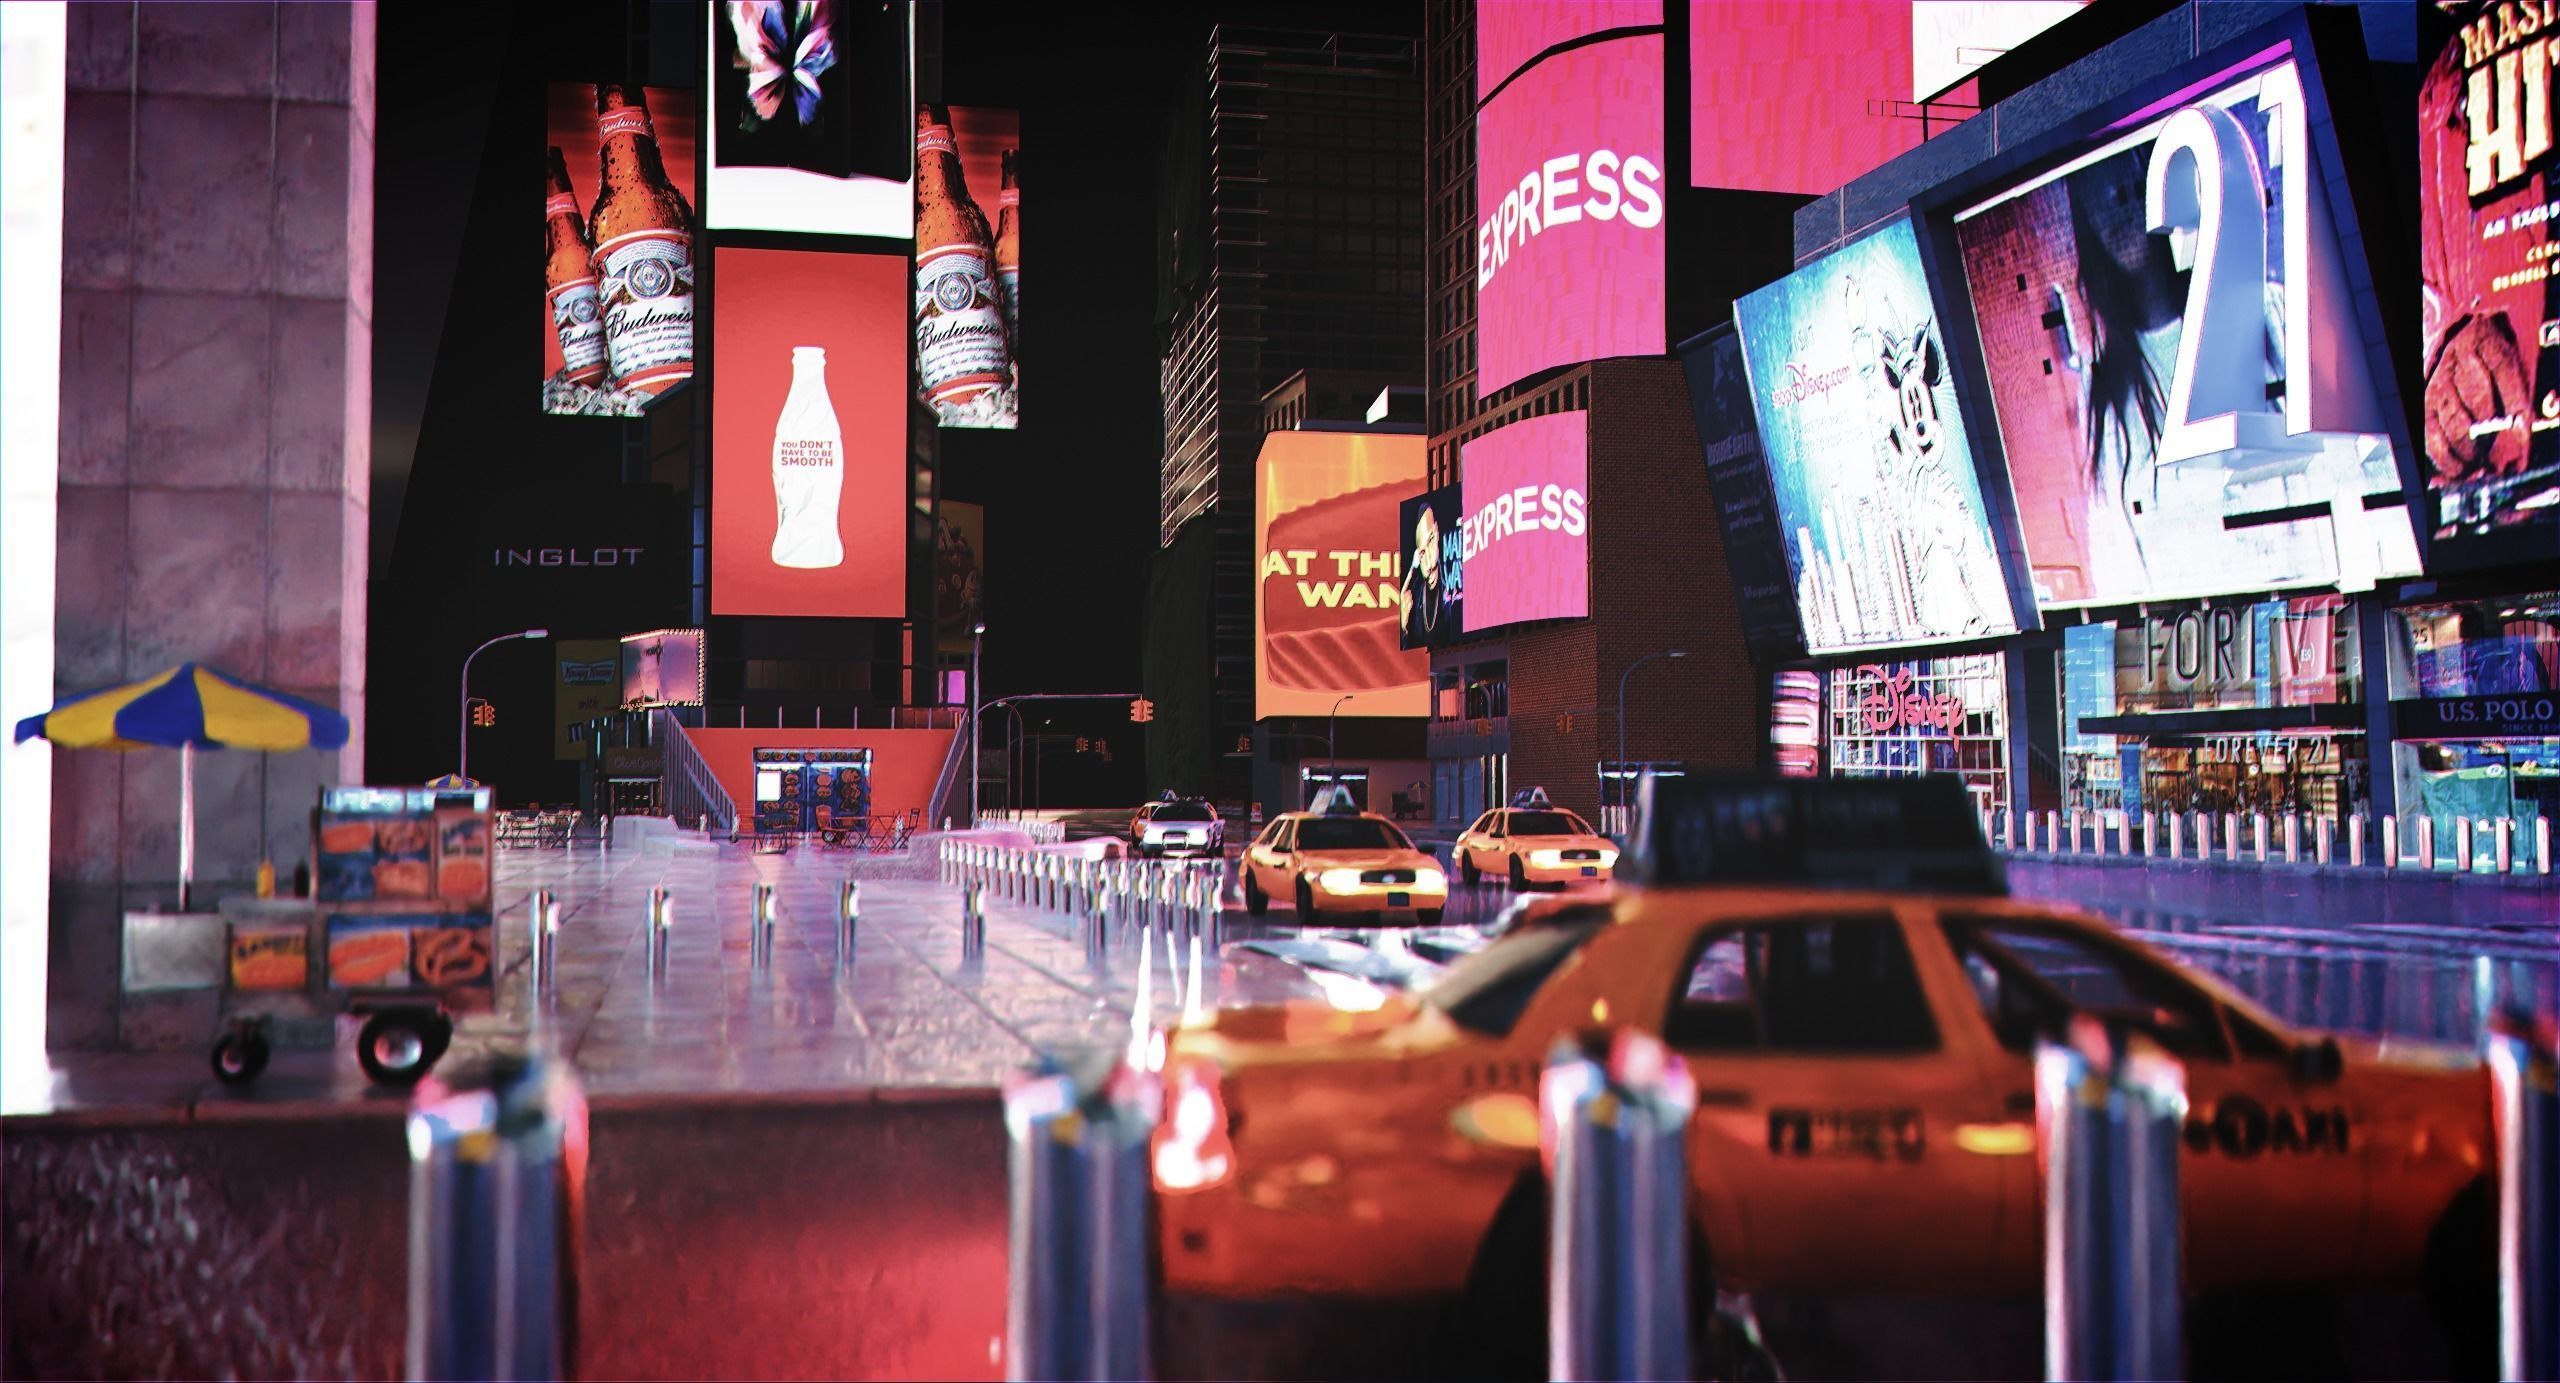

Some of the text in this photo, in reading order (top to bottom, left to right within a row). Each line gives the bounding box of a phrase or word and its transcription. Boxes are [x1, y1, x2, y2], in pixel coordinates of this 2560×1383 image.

[1478, 149, 1663, 292] EXPRESS
[2146, 59, 2312, 467] 21
[800, 440, 833, 449] DON'T
[781, 457, 833, 466] SMOOTH
[1463, 483, 1586, 563] EXPRESS
[495, 548, 645, 566] INGLOT
[2438, 699, 2554, 722] U.S. POLO
[2204, 735, 2332, 764] FOREVER 21
